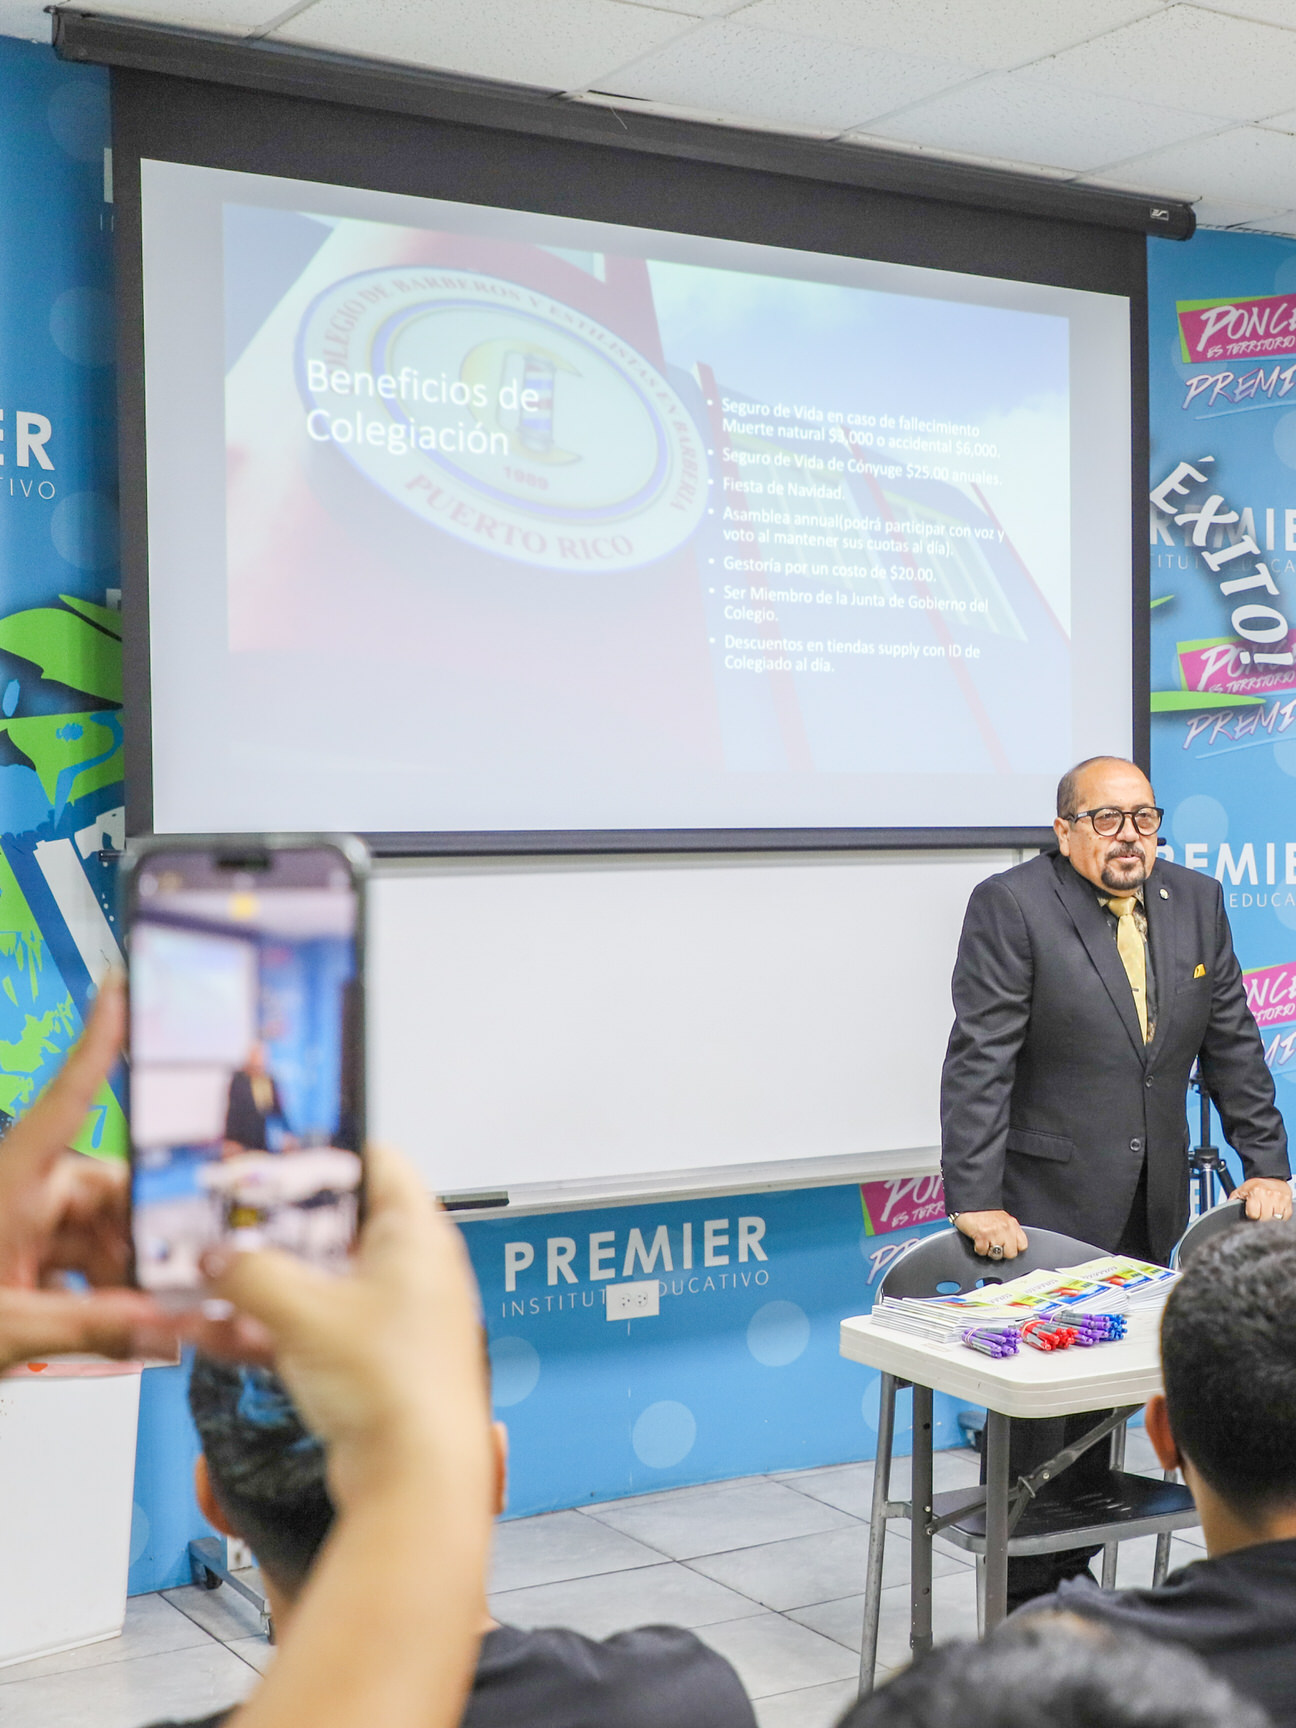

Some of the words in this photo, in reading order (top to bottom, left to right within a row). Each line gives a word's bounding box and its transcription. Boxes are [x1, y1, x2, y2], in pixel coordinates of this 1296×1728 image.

[357, 284, 393, 305] DE
[1207, 344, 1224, 358] ES
[307, 358, 489, 409] Beneficios
[498, 377, 541, 413] de
[306, 409, 510, 457] Colegiación
[721, 397, 770, 417] Seguro
[773, 402, 791, 418] de
[793, 404, 824, 421] Vida
[827, 411, 844, 424] en
[847, 412, 876, 428] caso
[879, 412, 896, 429] de
[899, 414, 981, 438] fallecimiento
[722, 418, 775, 437] Muerte
[777, 425, 826, 441] natural
[876, 436, 886, 447] o
[888, 436, 953, 454] accidental
[955, 441, 1001, 458] $6,000.
[722, 447, 772, 467] Seguro
[774, 452, 791, 467] de
[793, 454, 824, 470] Vida
[827, 456, 845, 472] de
[847, 457, 903, 480] Cónyuge
[906, 462, 949, 481] $25.00
[952, 470, 1002, 486] anuales.
[723, 476, 764, 493] Fiesta
[767, 480, 784, 496] de
[787, 482, 846, 500] Navidad.
[404, 473, 549, 555] PUERTO
[556, 534, 635, 561] RICO
[722, 506, 791, 525] Asamblea
[885, 520, 946, 537] participar
[949, 525, 971, 538] con
[974, 527, 995, 540] voz
[997, 530, 1005, 543] y
[722, 528, 755, 543] voto
[758, 529, 771, 544] al
[774, 532, 839, 548] mantener
[842, 538, 864, 550] sus
[866, 539, 909, 553] cuotas
[912, 540, 924, 554] al
[723, 555, 782, 573] Gestoría
[785, 562, 808, 577] por
[811, 563, 829, 576] un
[832, 564, 868, 578] costo
[870, 564, 887, 579] de
[890, 565, 937, 583] $20.00.
[1149, 455, 1294, 667] ÉXITO!
[723, 585, 747, 600] Ser
[750, 586, 813, 604] Miembro
[816, 589, 833, 605] de
[836, 590, 848, 606] la
[850, 591, 886, 608] Junta
[888, 594, 905, 609] de
[908, 595, 967, 612] Gobierno
[969, 598, 989, 613] del
[723, 605, 779, 624] Colegio.
[724, 634, 804, 652] Descuentos
[806, 640, 824, 652] en
[827, 638, 875, 654] tiendas
[878, 641, 920, 659] supply
[922, 645, 945, 658] con
[948, 644, 962, 657] ID
[965, 644, 981, 659] de
[724, 655, 793, 673] Colegiado
[795, 657, 808, 672] al
[810, 658, 835, 673] día.
[504, 1215, 769, 1292] PREMIER
[502, 1287, 607, 1319] INSTITUT
[659, 1269, 769, 1298] DUCATIVO
